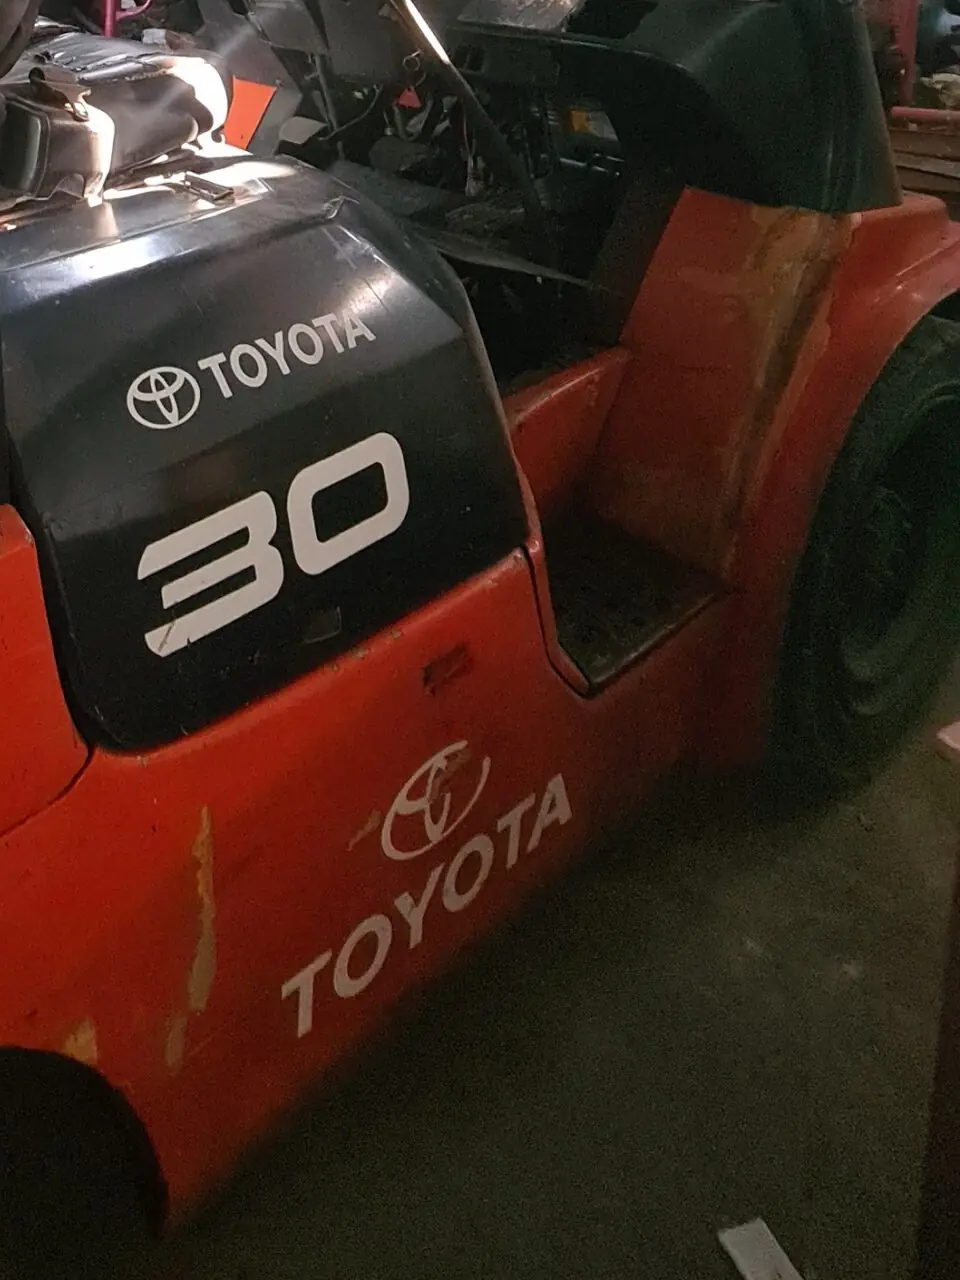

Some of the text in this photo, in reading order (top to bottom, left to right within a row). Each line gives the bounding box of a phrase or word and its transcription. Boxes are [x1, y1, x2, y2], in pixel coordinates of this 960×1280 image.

[197, 308, 377, 399] TOYOTA
[137, 431, 410, 658] 30
[280, 773, 573, 1038] TOYOTA
